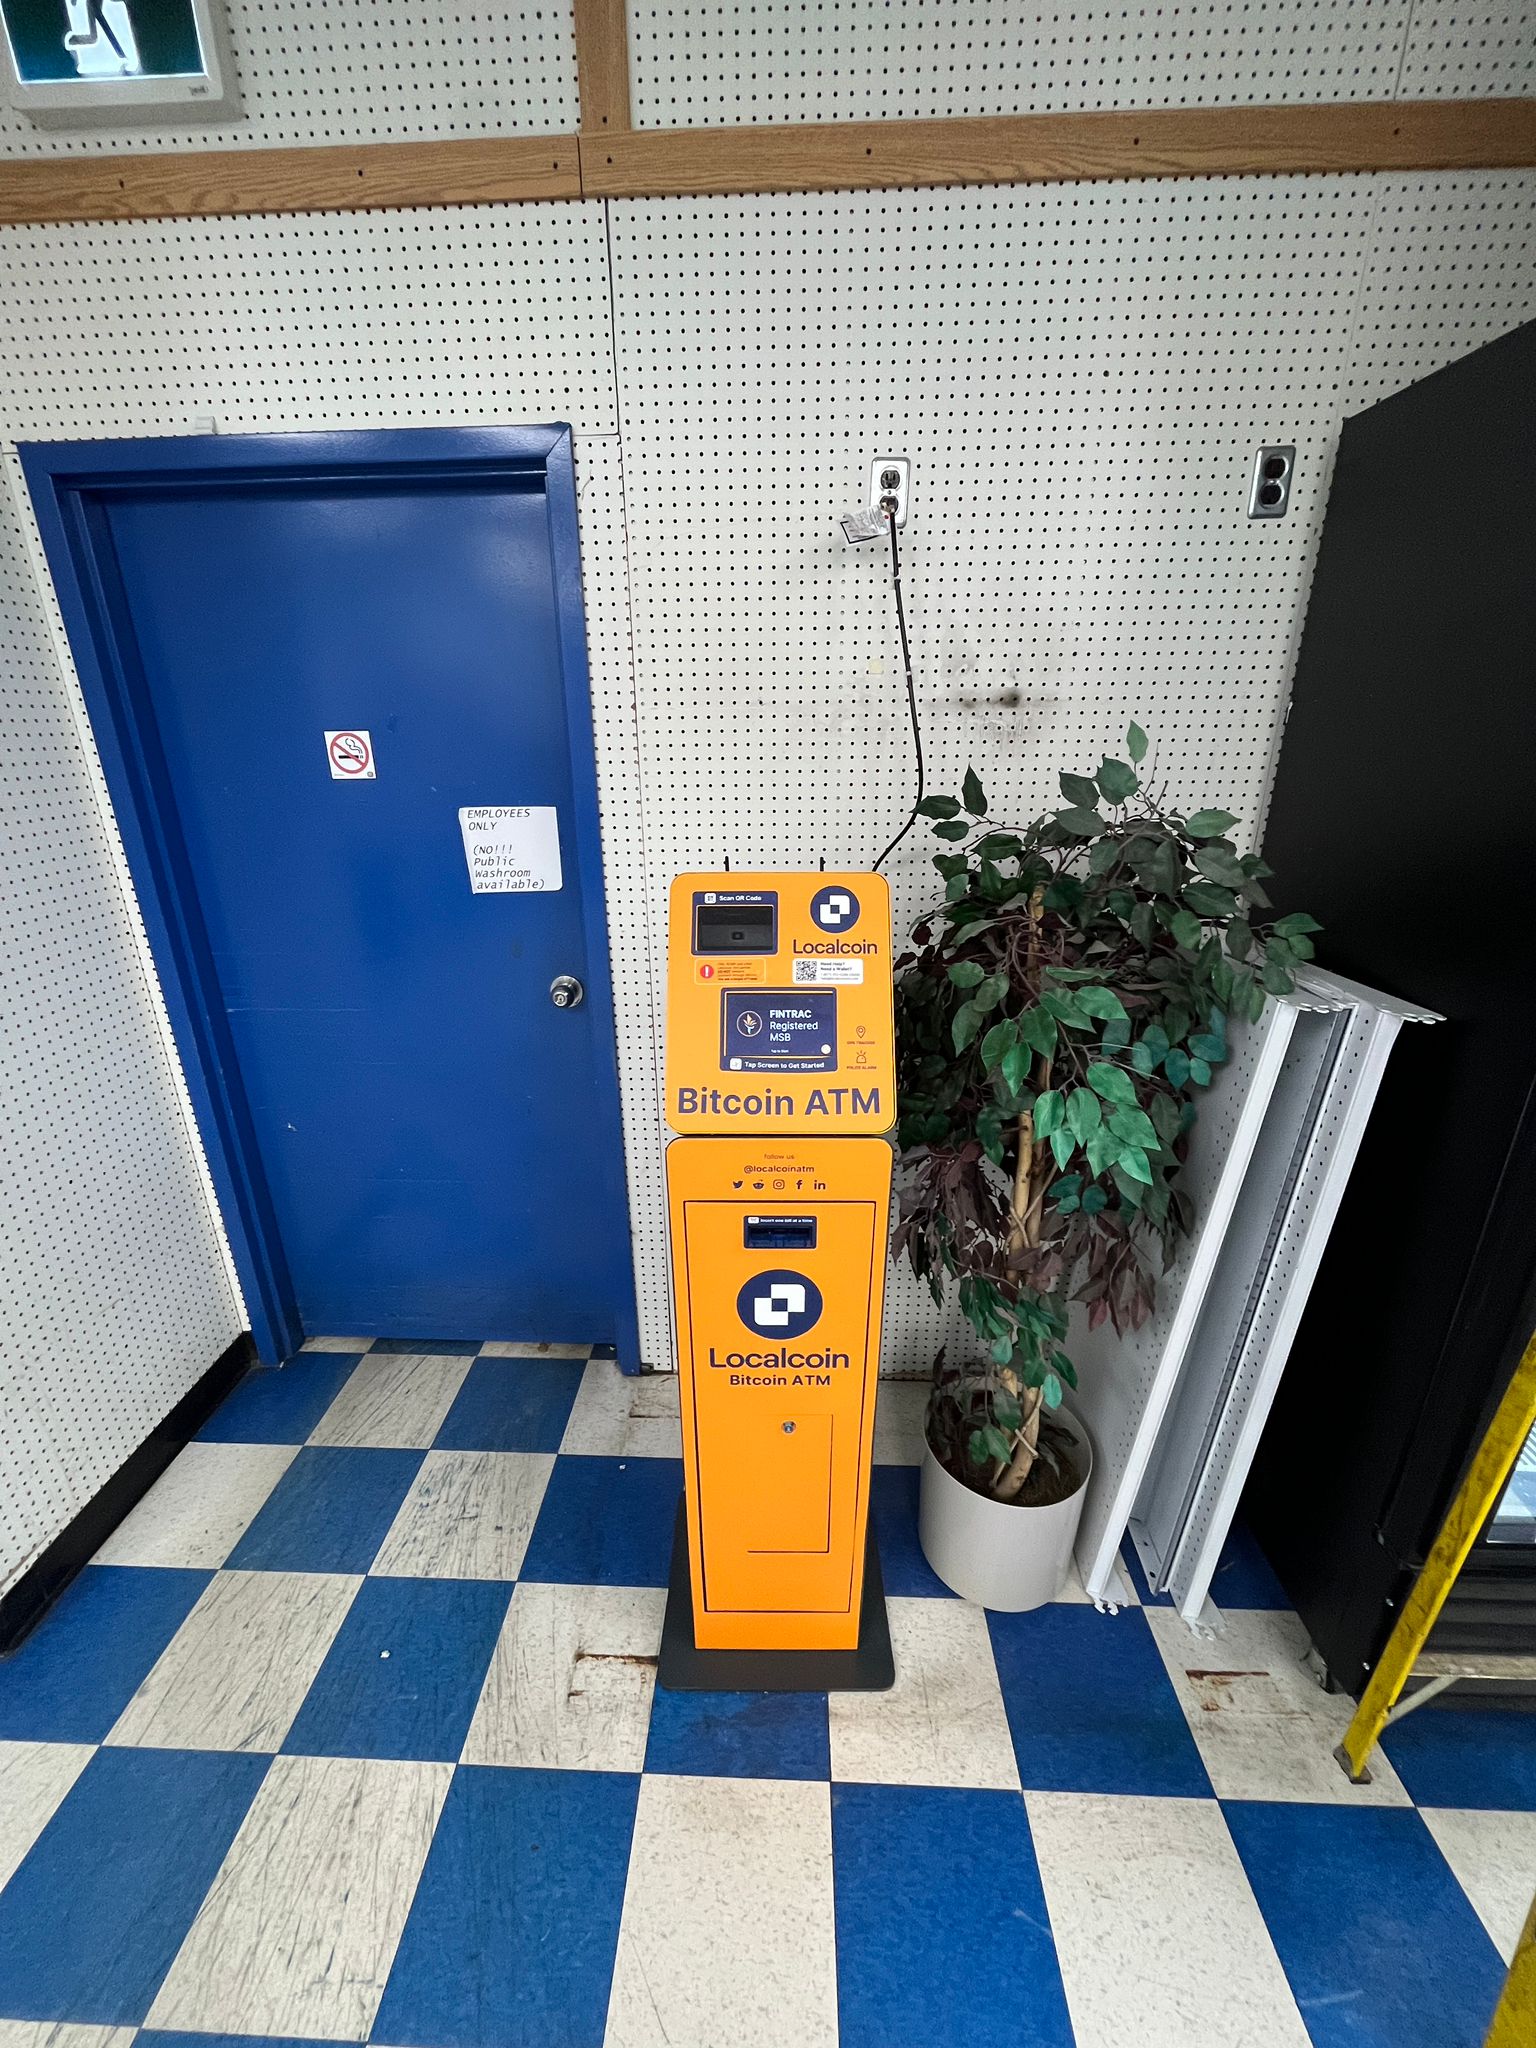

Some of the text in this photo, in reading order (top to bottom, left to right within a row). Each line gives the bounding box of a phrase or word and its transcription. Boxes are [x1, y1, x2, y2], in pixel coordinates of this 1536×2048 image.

[467, 808, 530, 819] EMPLOYEES
[468, 821, 497, 831] ONLY
[473, 844, 513, 856] (NO!!!
[474, 856, 515, 866] Public
[477, 878, 545, 890] available)
[793, 939, 878, 954] Localcoin
[769, 1009, 812, 1019] FINTRAC
[769, 1021, 819, 1032] Registered
[769, 1033, 791, 1042] MSB
[745, 1061, 756, 1069] Tap
[757, 1061, 779, 1069] Screen
[678, 1087, 880, 1115] Bitcoin ATM
[743, 1164, 815, 1174] @localcoinatm
[709, 1347, 850, 1369] Localcoin
[730, 1374, 831, 1386] Bitcoin ATM
